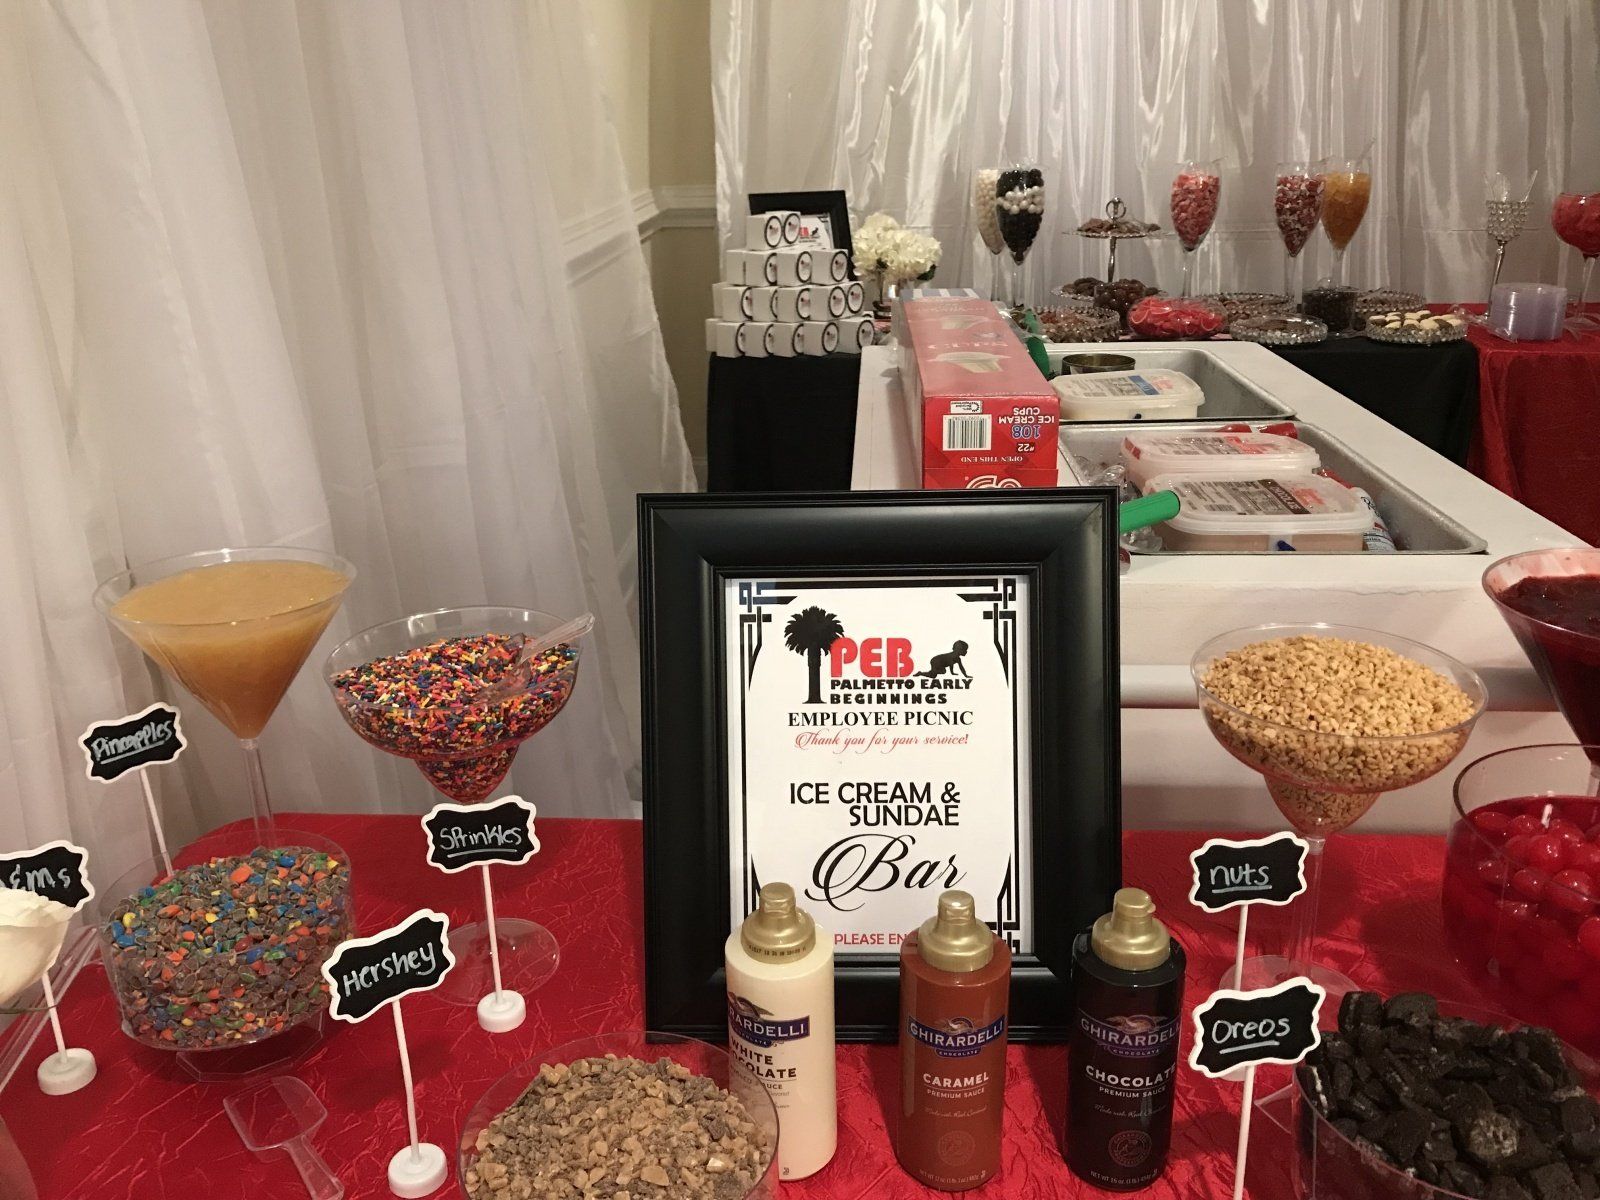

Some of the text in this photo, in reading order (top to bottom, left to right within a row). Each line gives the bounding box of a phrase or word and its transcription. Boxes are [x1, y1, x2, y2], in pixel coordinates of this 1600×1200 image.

[998, 415, 1035, 424] CREAM
[1013, 407, 1041, 415] CUPS
[1038, 415, 1055, 424] ICE
[1011, 425, 1041, 440] 108
[1017, 443, 1035, 453] #22
[830, 636, 916, 678] PEB
[830, 677, 973, 690] PALMETTO EARLY
[830, 693, 948, 705] BEGINNINGS
[788, 711, 974, 727] EMPLOYEE PICNIC
[91, 720, 173, 761] Pineapples
[794, 728, 969, 755] Thank you for your service!
[789, 782, 961, 805] ICE CREAM &
[849, 805, 960, 827] SUNDAE
[804, 833, 968, 912] Bar
[1209, 862, 1271, 887] nuts
[834, 933, 885, 945] PLEASE
[342, 941, 437, 997] Hershey
[729, 1006, 804, 1037] RARDELLI
[1211, 1017, 1291, 1045] Oreos
[910, 1020, 1003, 1047] GHIRARDELLI
[731, 1036, 773, 1066] WHITE
[731, 1050, 797, 1079] OCOLATE
[1085, 1063, 1176, 1088] CHOCOLATE
[922, 1072, 989, 1088] CARAMEL
[926, 1088, 985, 1099] PREMIUM SAUCE
[1099, 1086, 1167, 1099] PREMIUM SAUCE
